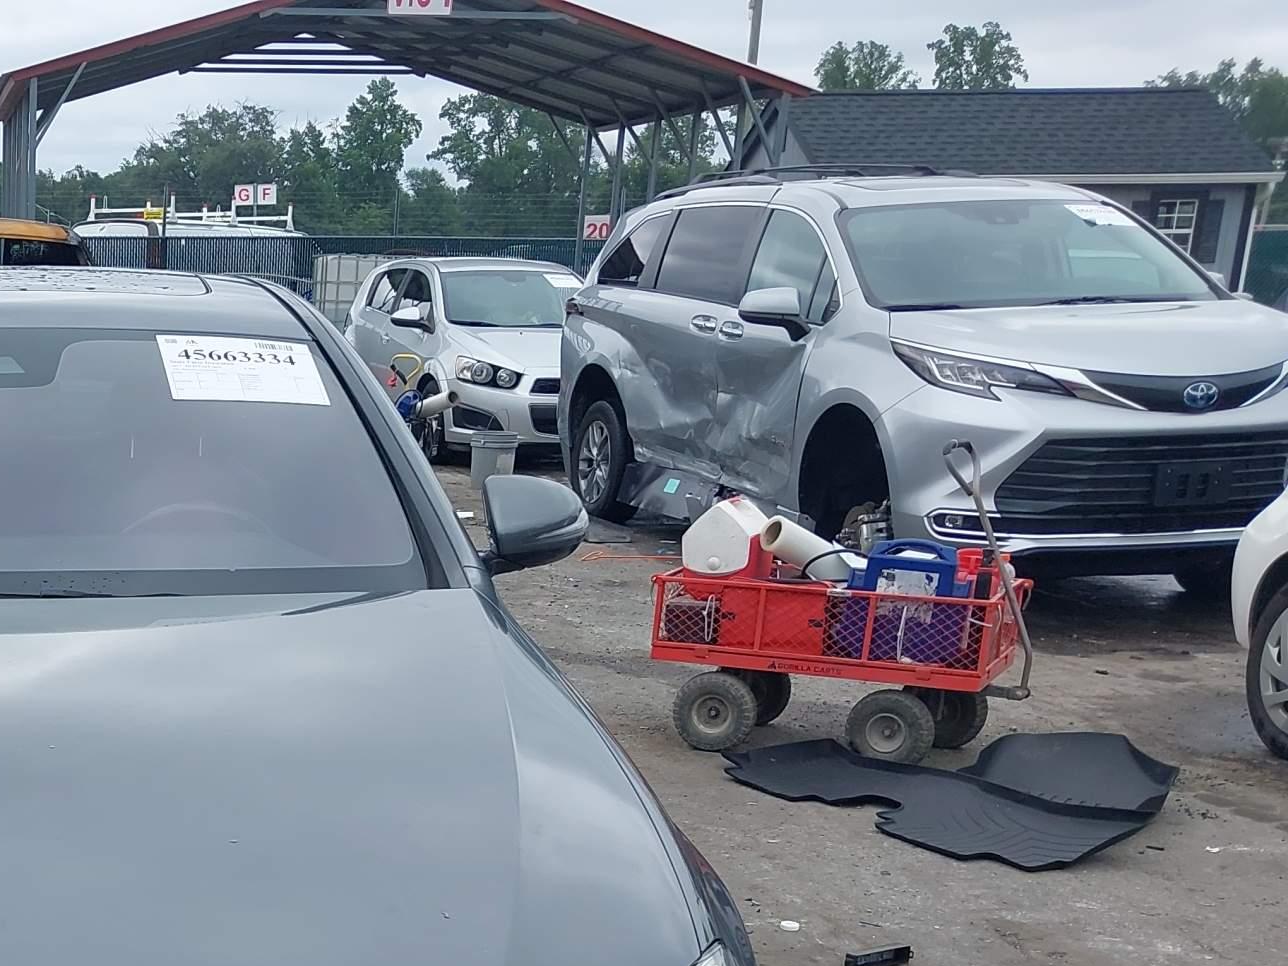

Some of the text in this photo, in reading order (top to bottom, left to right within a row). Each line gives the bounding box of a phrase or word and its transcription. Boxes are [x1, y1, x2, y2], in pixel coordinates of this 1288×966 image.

[238, 188, 250, 202] G
[262, 187, 271, 201] F
[586, 223, 609, 238] 20
[177, 348, 296, 366] 45663334
